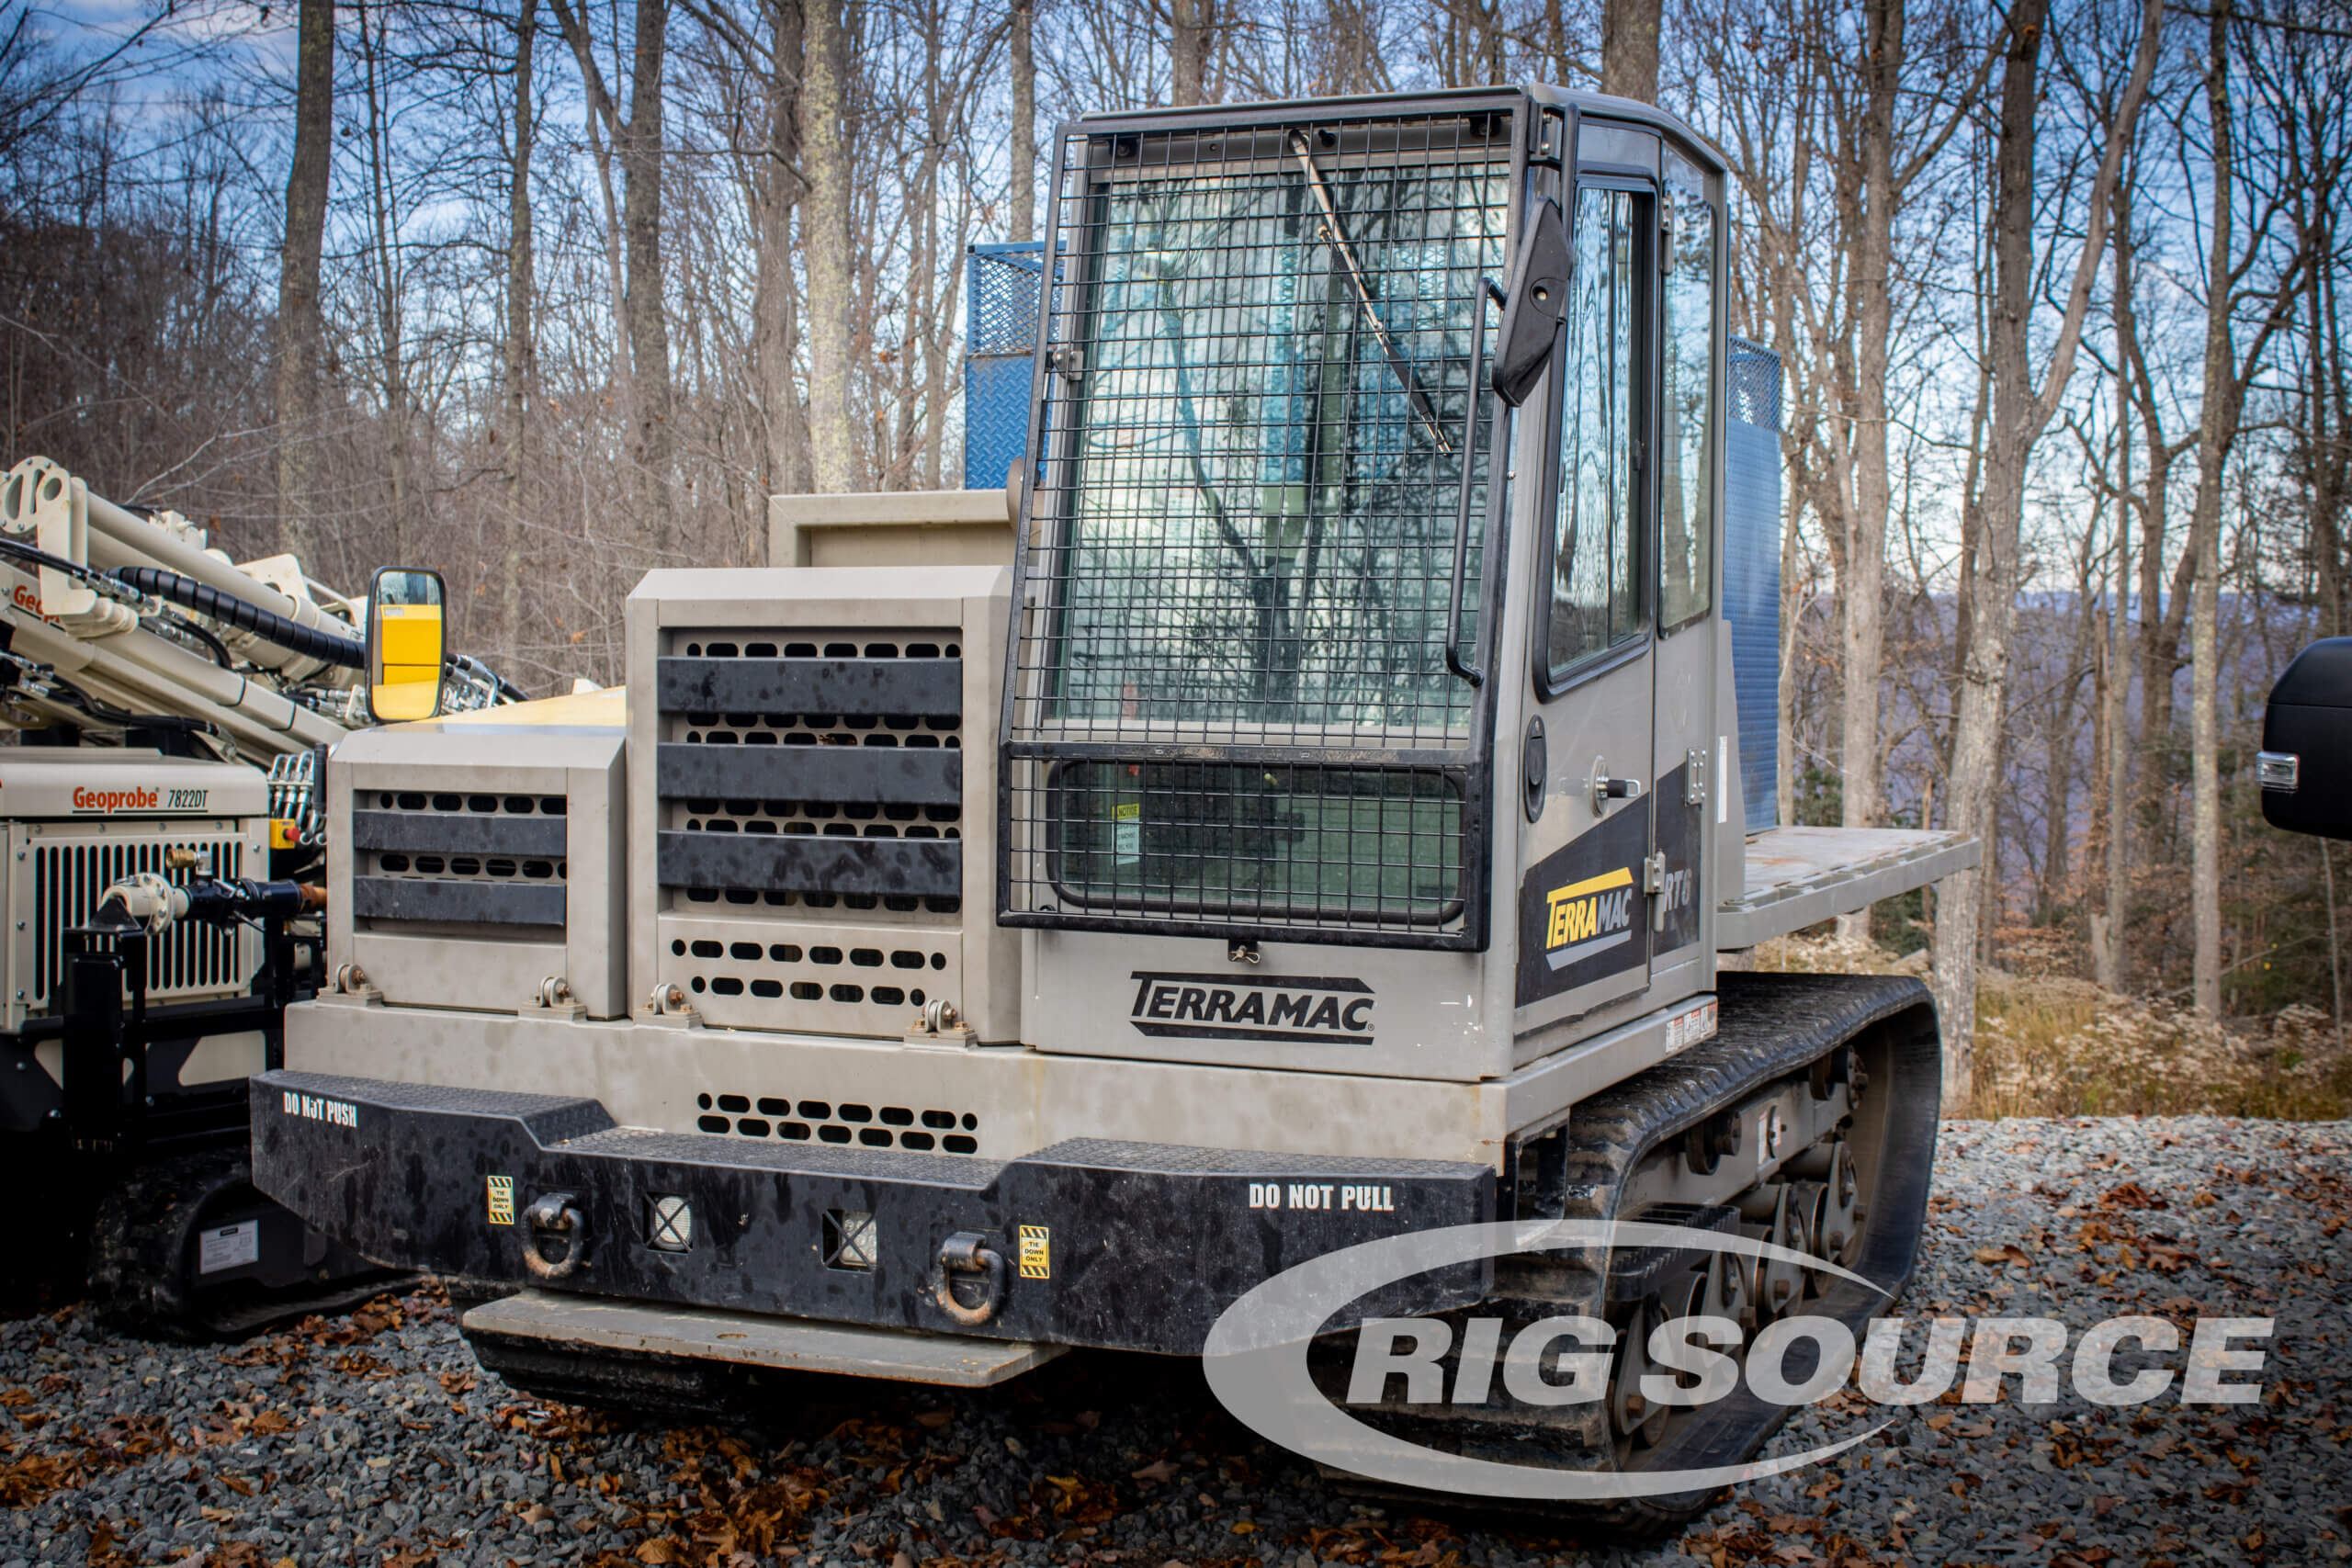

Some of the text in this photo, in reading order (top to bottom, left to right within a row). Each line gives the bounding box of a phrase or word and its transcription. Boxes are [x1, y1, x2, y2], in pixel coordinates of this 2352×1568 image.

[167, 789, 209, 808] 7822DT
[1545, 866, 1634, 950] TERRAMAC
[283, 1090, 358, 1128] DO NOT PUSH
[1249, 1182, 1396, 1213] DO NOT PULL
